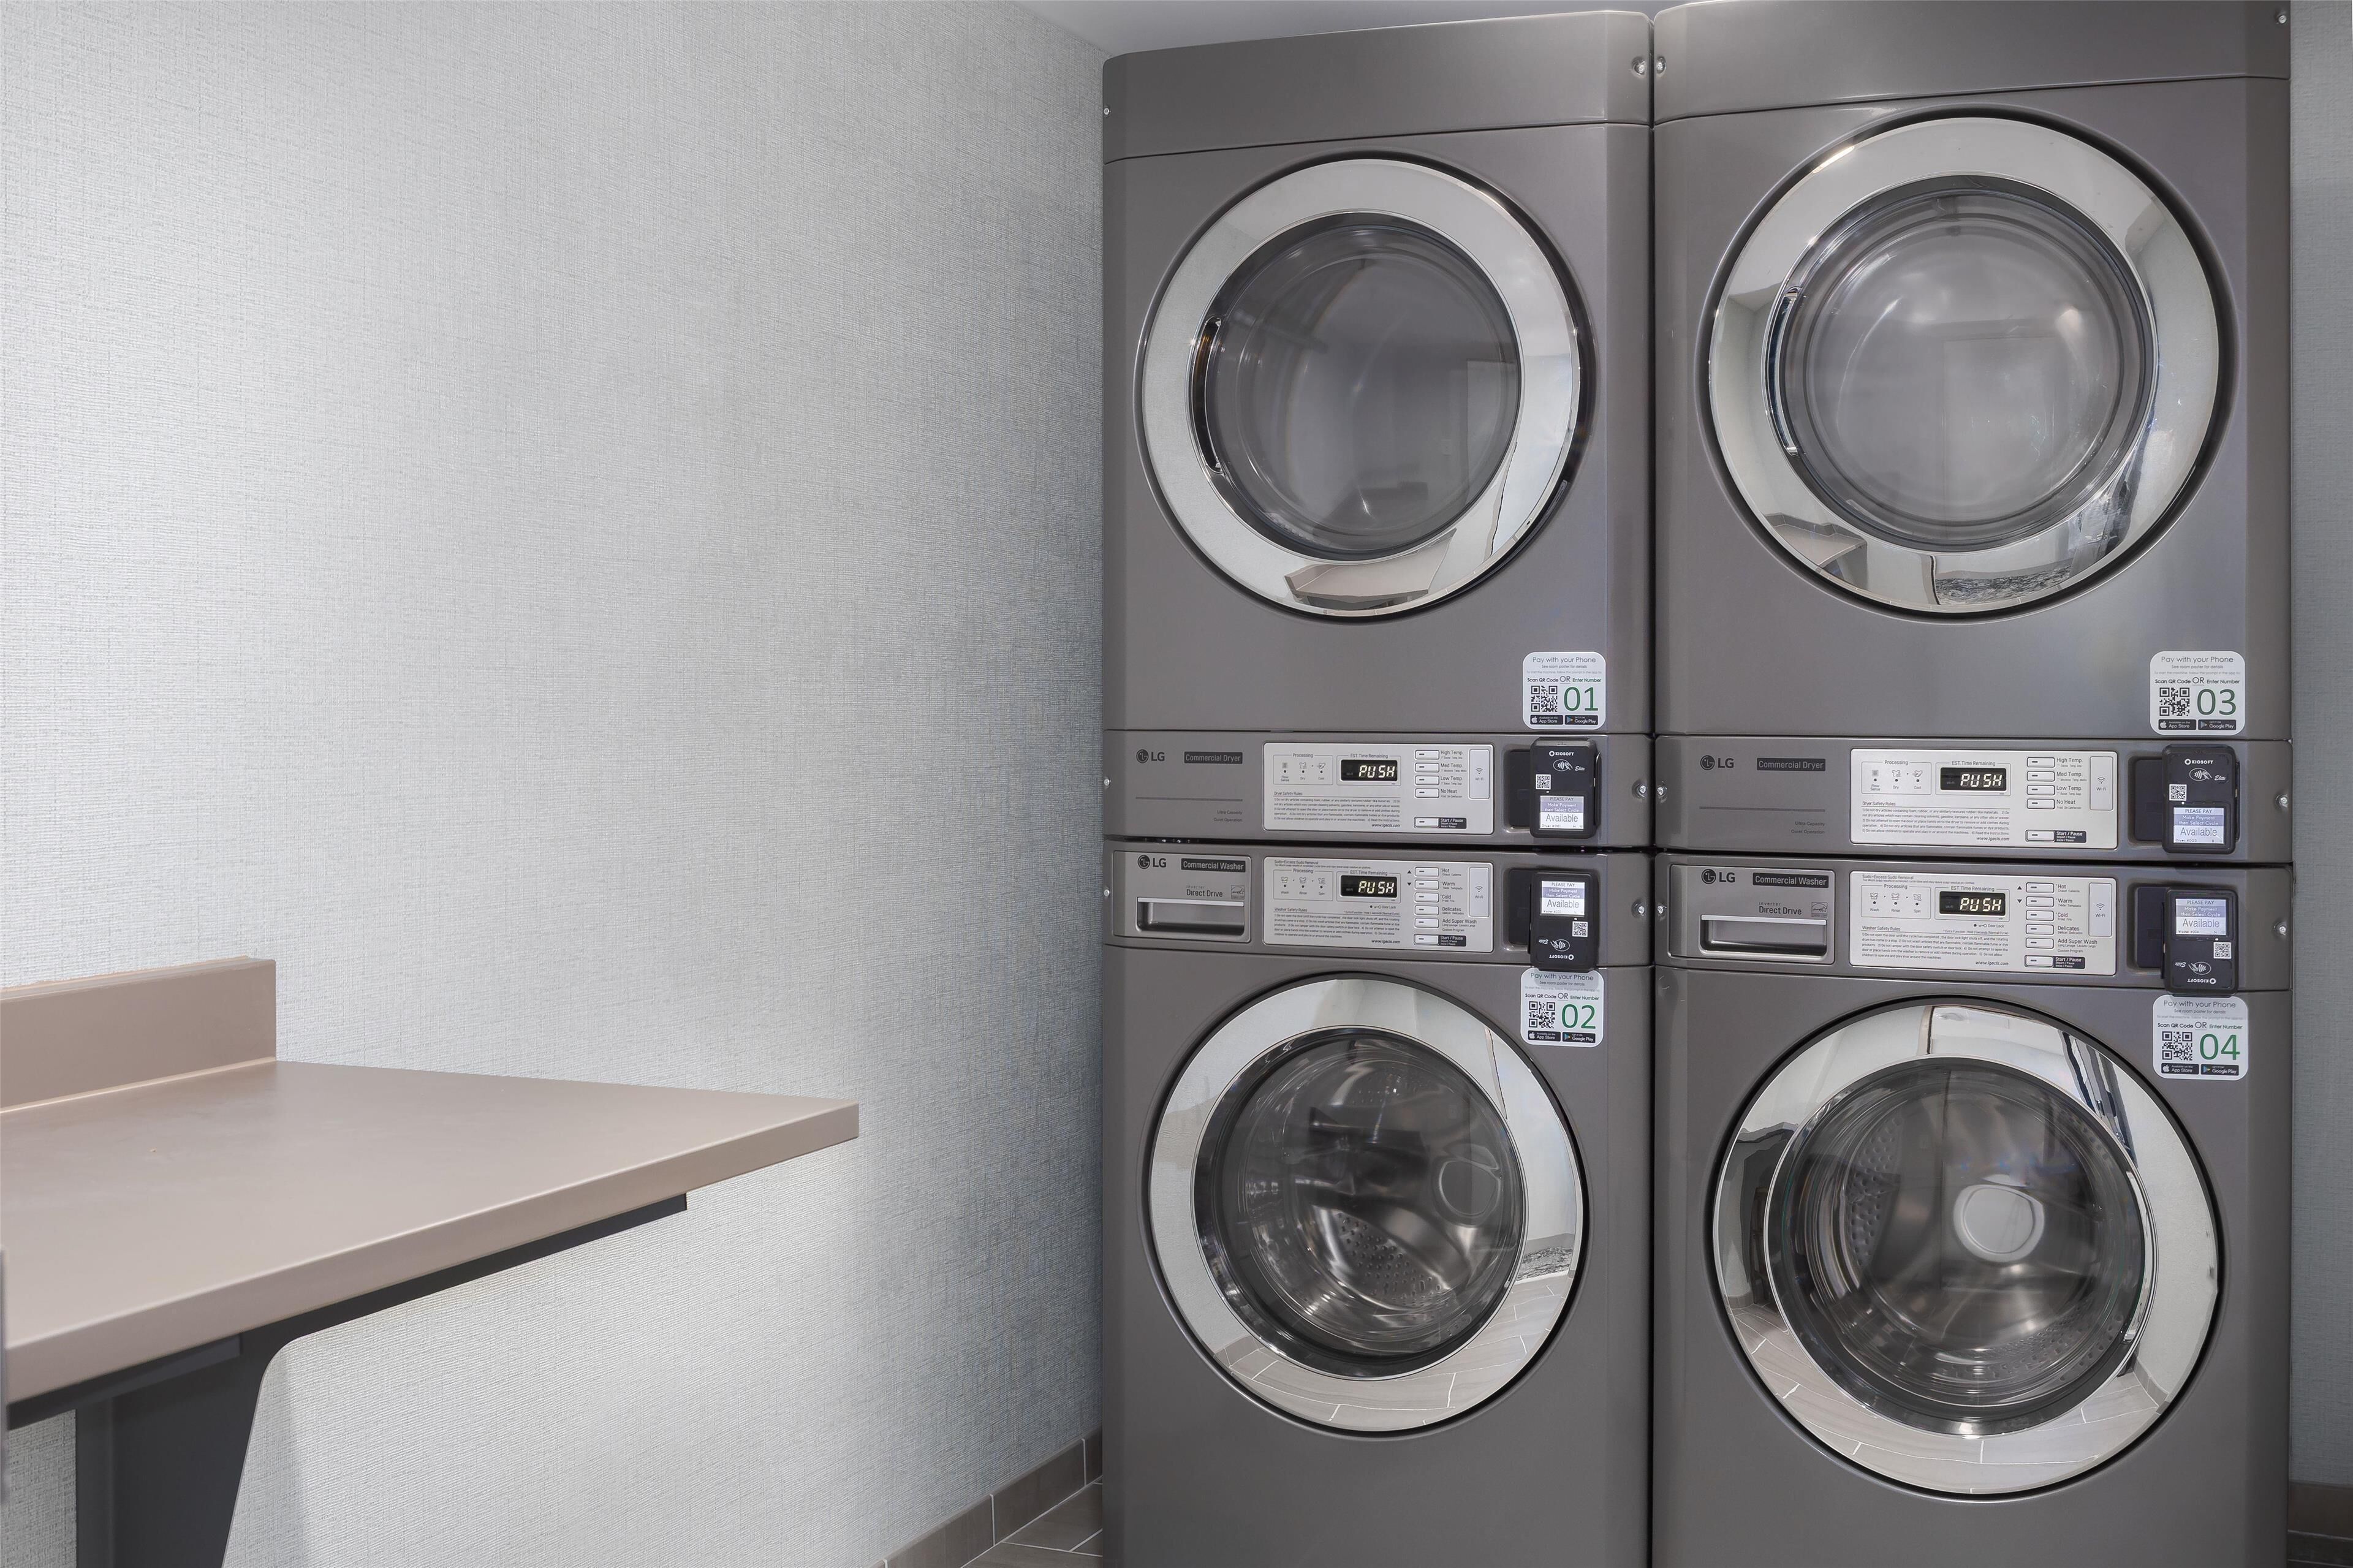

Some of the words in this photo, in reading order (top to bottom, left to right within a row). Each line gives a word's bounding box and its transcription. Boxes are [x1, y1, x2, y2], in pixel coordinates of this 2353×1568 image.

[1564, 686, 1599, 711] 01
[2197, 689, 2237, 716] 03
[1358, 765, 1395, 778] PUSH
[1803, 761, 1824, 770] Dryer
[1960, 774, 2003, 787] PUSH
[1545, 814, 1578, 822] Available
[2180, 827, 2218, 836] Available
[1183, 860, 1219, 869] Commercial
[1755, 876, 1797, 885] Commercial
[1798, 877, 1827, 885] Washer
[1358, 881, 1395, 893] PUSH
[1547, 899, 1579, 908] Available
[1960, 897, 2002, 912] PUSH
[2183, 918, 2219, 928] Available
[1562, 1004, 1596, 1029] 02
[2200, 1034, 2240, 1061] 04
